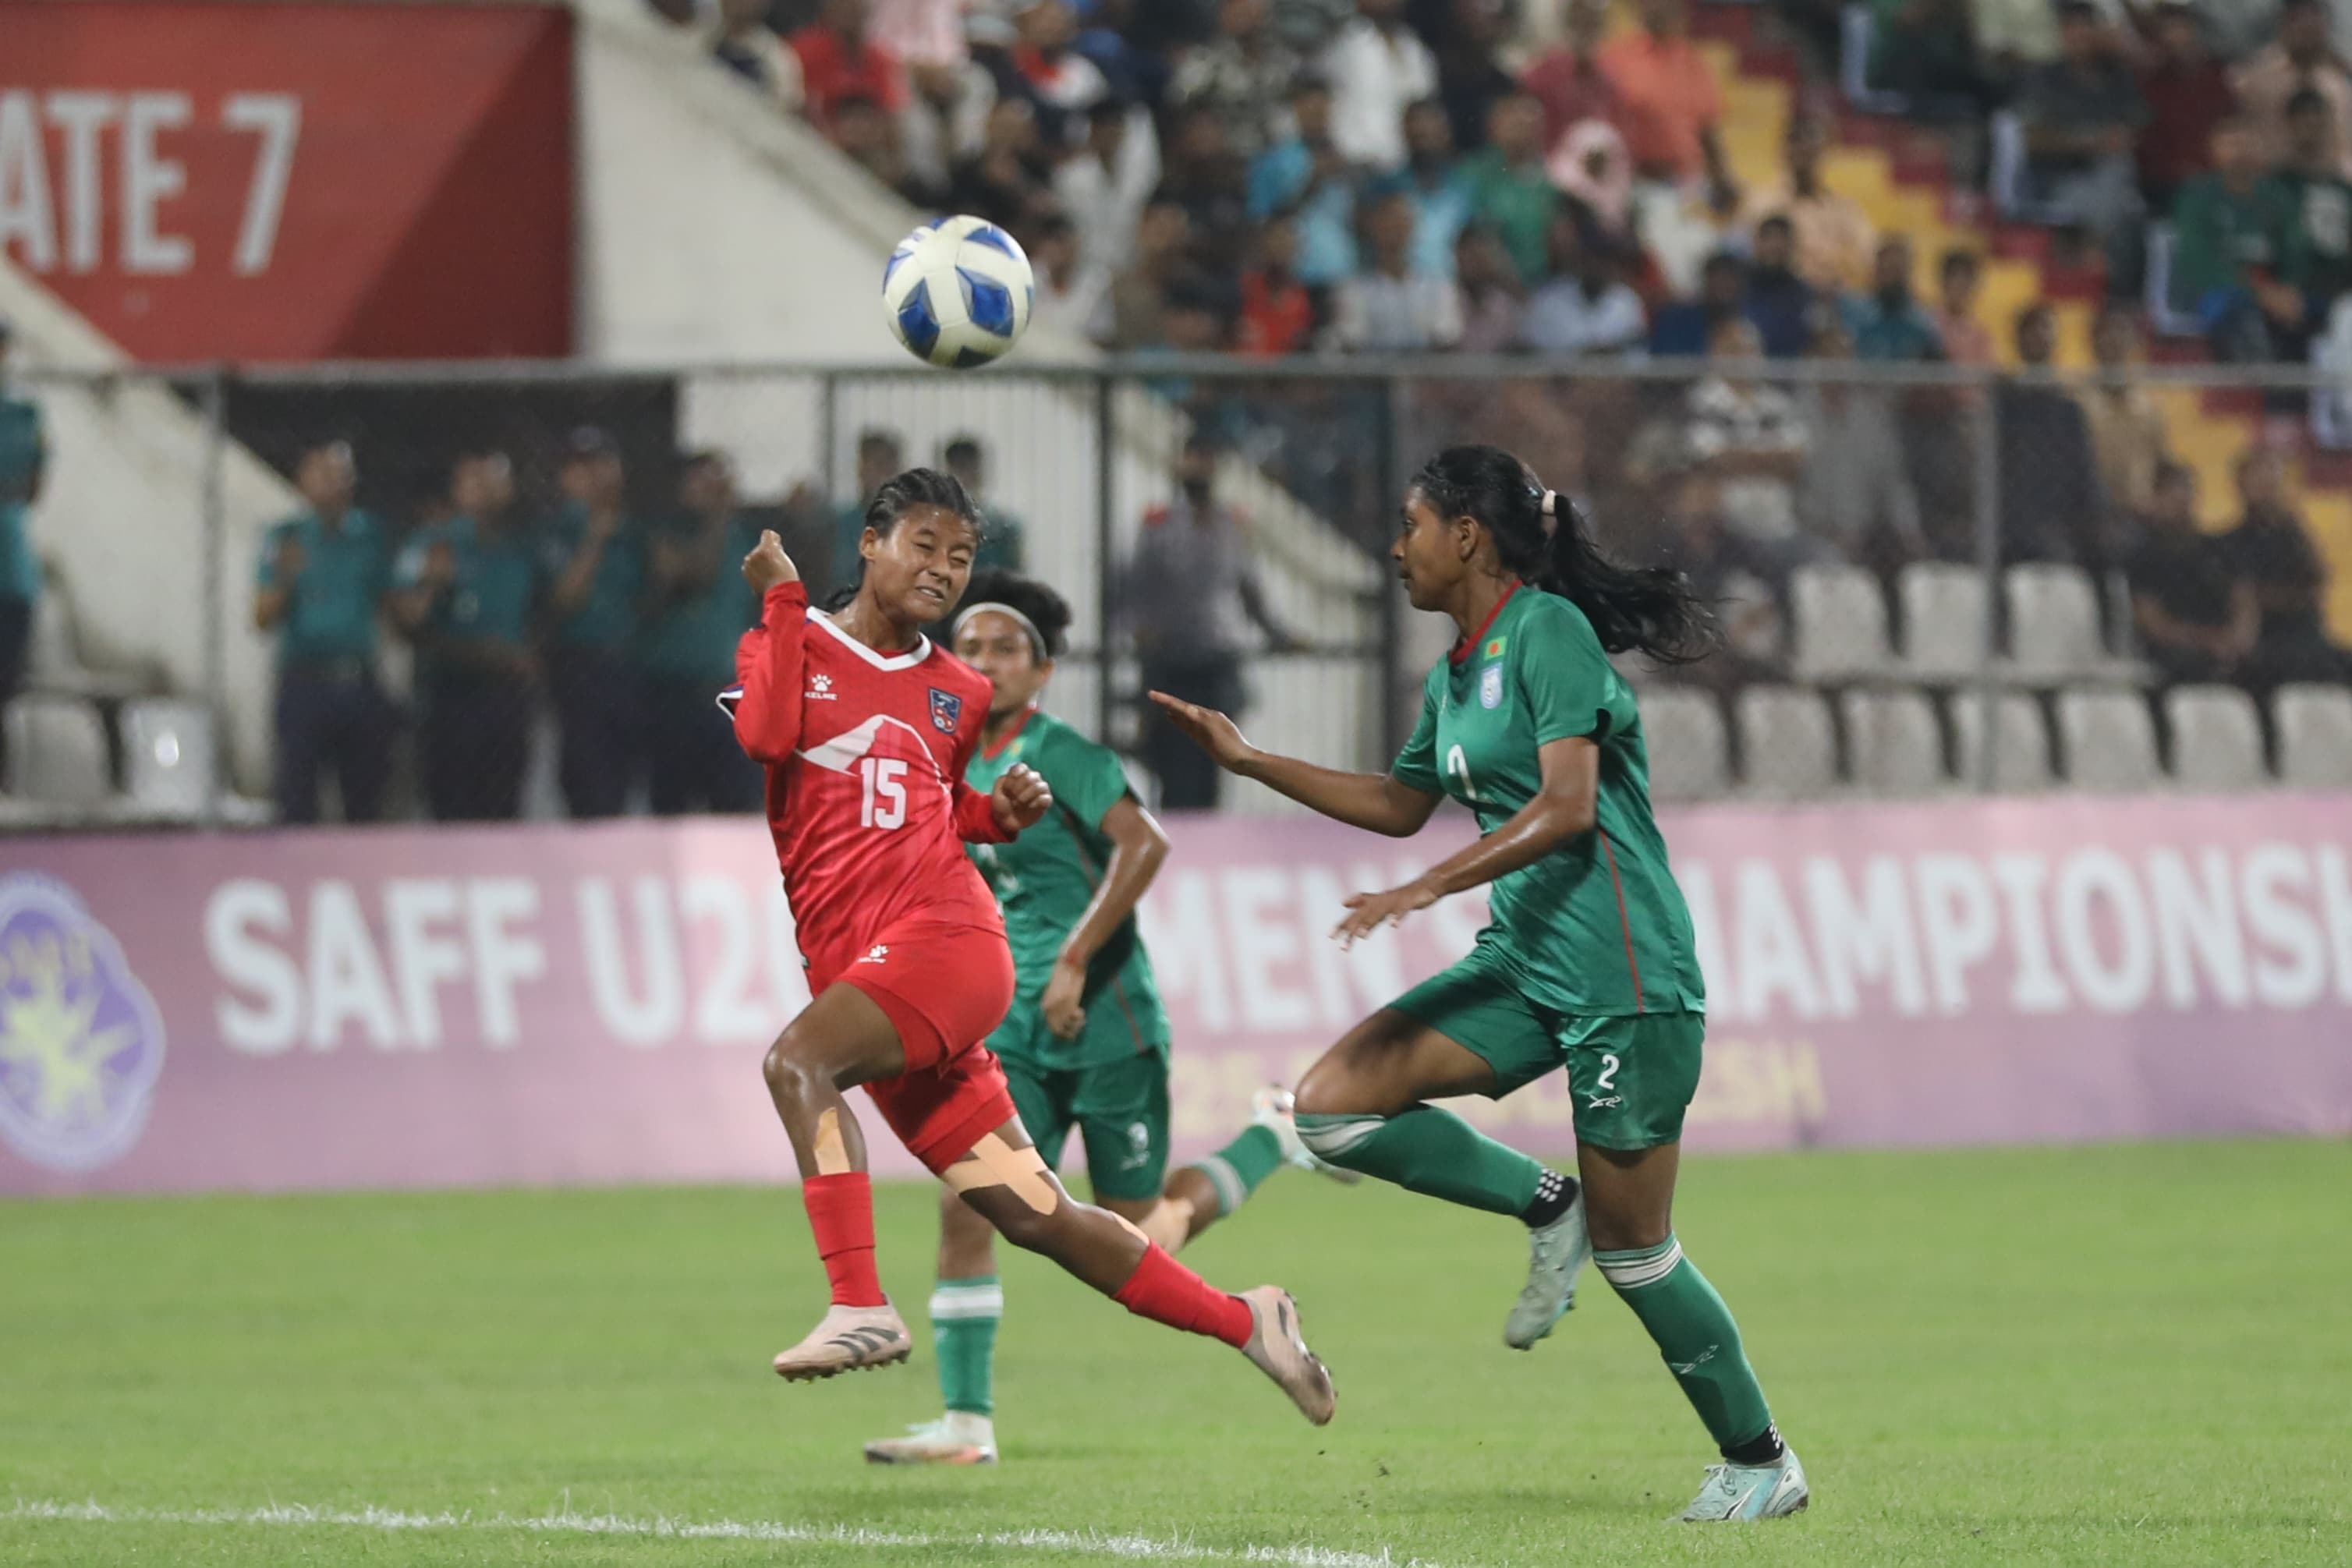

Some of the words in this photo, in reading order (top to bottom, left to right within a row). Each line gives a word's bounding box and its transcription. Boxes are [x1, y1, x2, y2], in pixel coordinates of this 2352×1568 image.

[221, 90, 303, 278] 7
[860, 757, 908, 830] 15
[204, 876, 546, 1057] SAFF
[1598, 1054, 1620, 1089] 2
